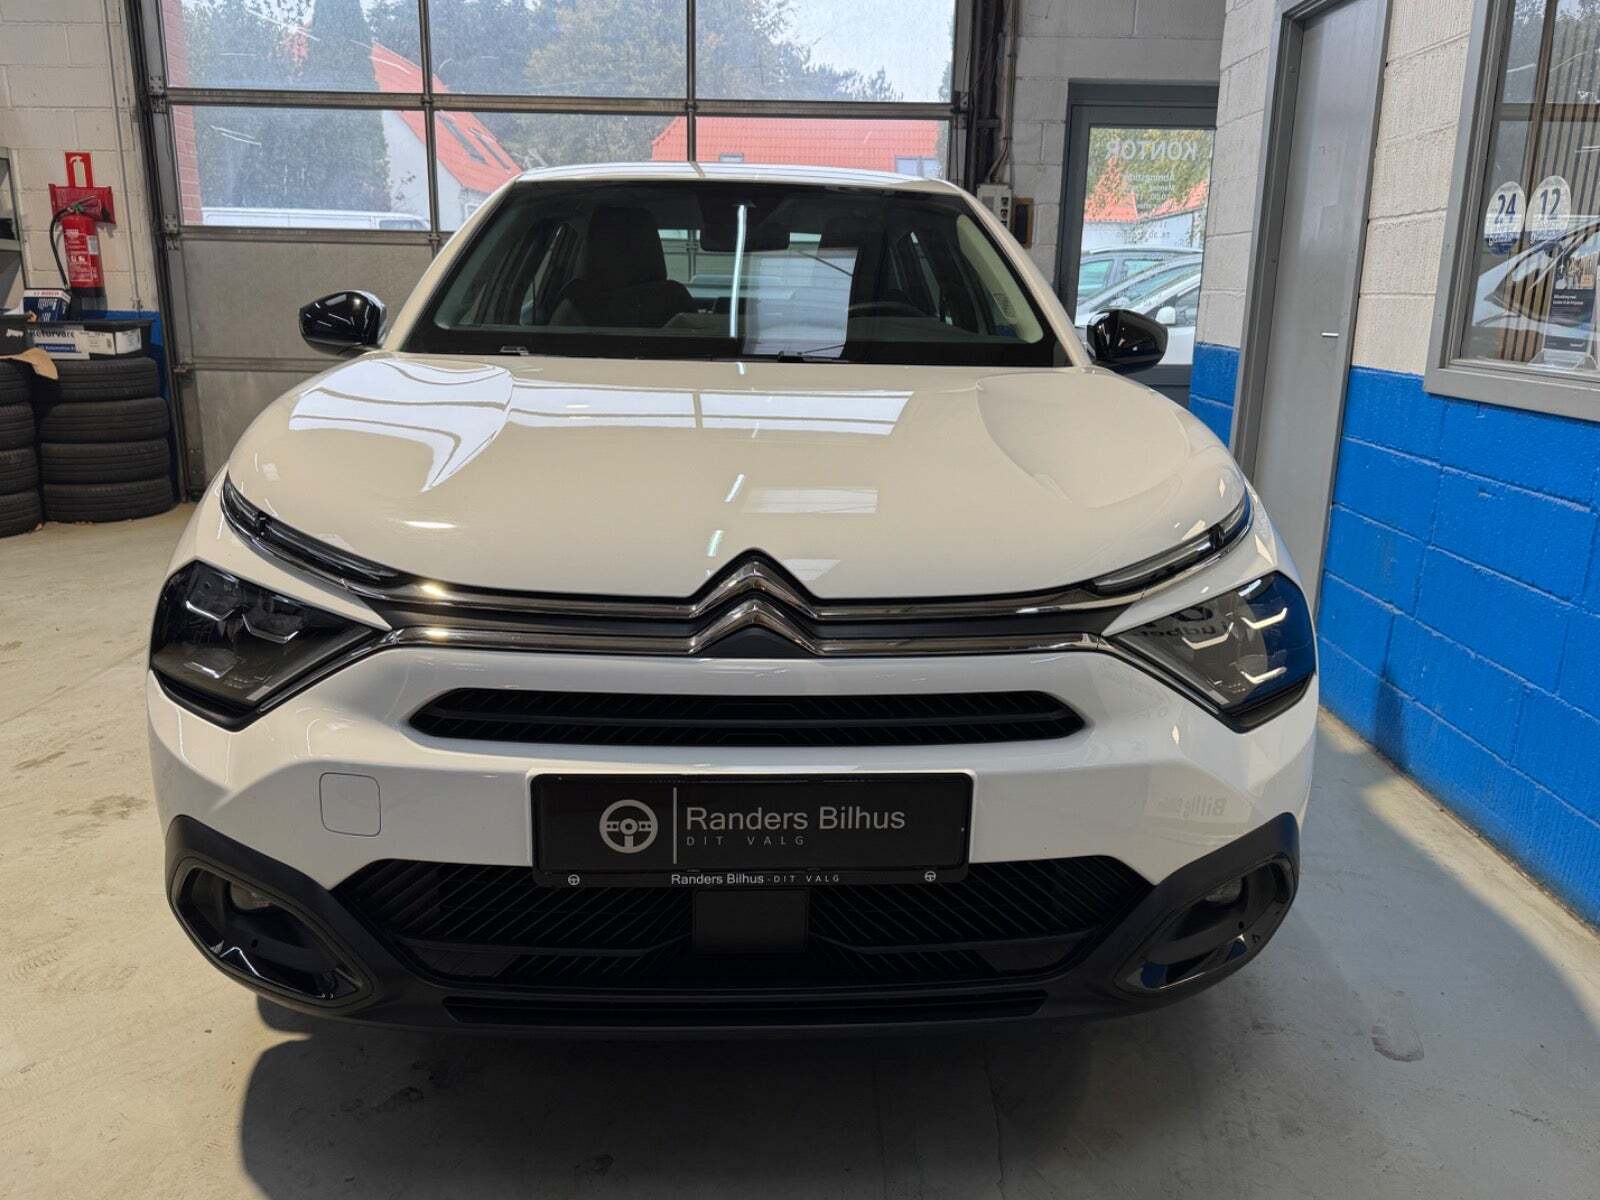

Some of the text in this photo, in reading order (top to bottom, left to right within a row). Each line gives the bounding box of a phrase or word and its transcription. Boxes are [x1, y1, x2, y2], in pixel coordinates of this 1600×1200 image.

[1494, 192, 1517, 225] 24
[1540, 187, 1562, 221] 12
[686, 806, 905, 830] Randers Bilhus
[686, 836, 804, 847] DIT VALG
[671, 874, 723, 885] Randers
[727, 873, 764, 884] Bilhus
[805, 875, 839, 883] VALG
